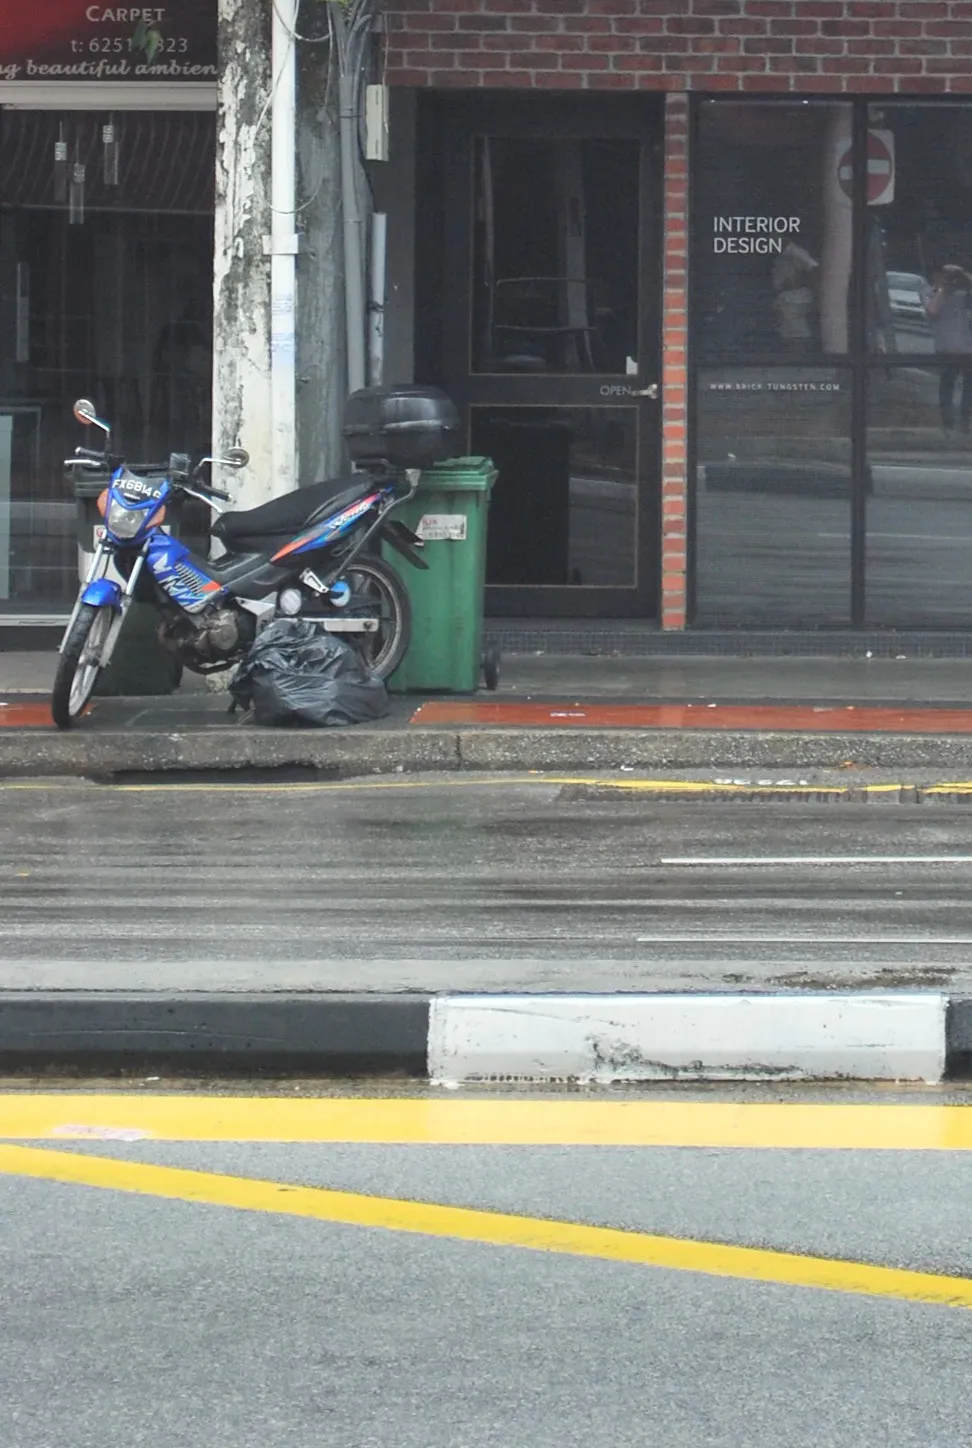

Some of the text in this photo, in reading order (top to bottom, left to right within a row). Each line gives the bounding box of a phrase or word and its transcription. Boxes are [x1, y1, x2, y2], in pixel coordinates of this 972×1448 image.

[86, 5, 166, 22] CARPET
[89, 38, 133, 53] 6251
[26, 59, 131, 78] beautiful
[713, 216, 801, 233] INTERIOR
[713, 237, 782, 254] DESIGN
[599, 384, 632, 396] OPEN
